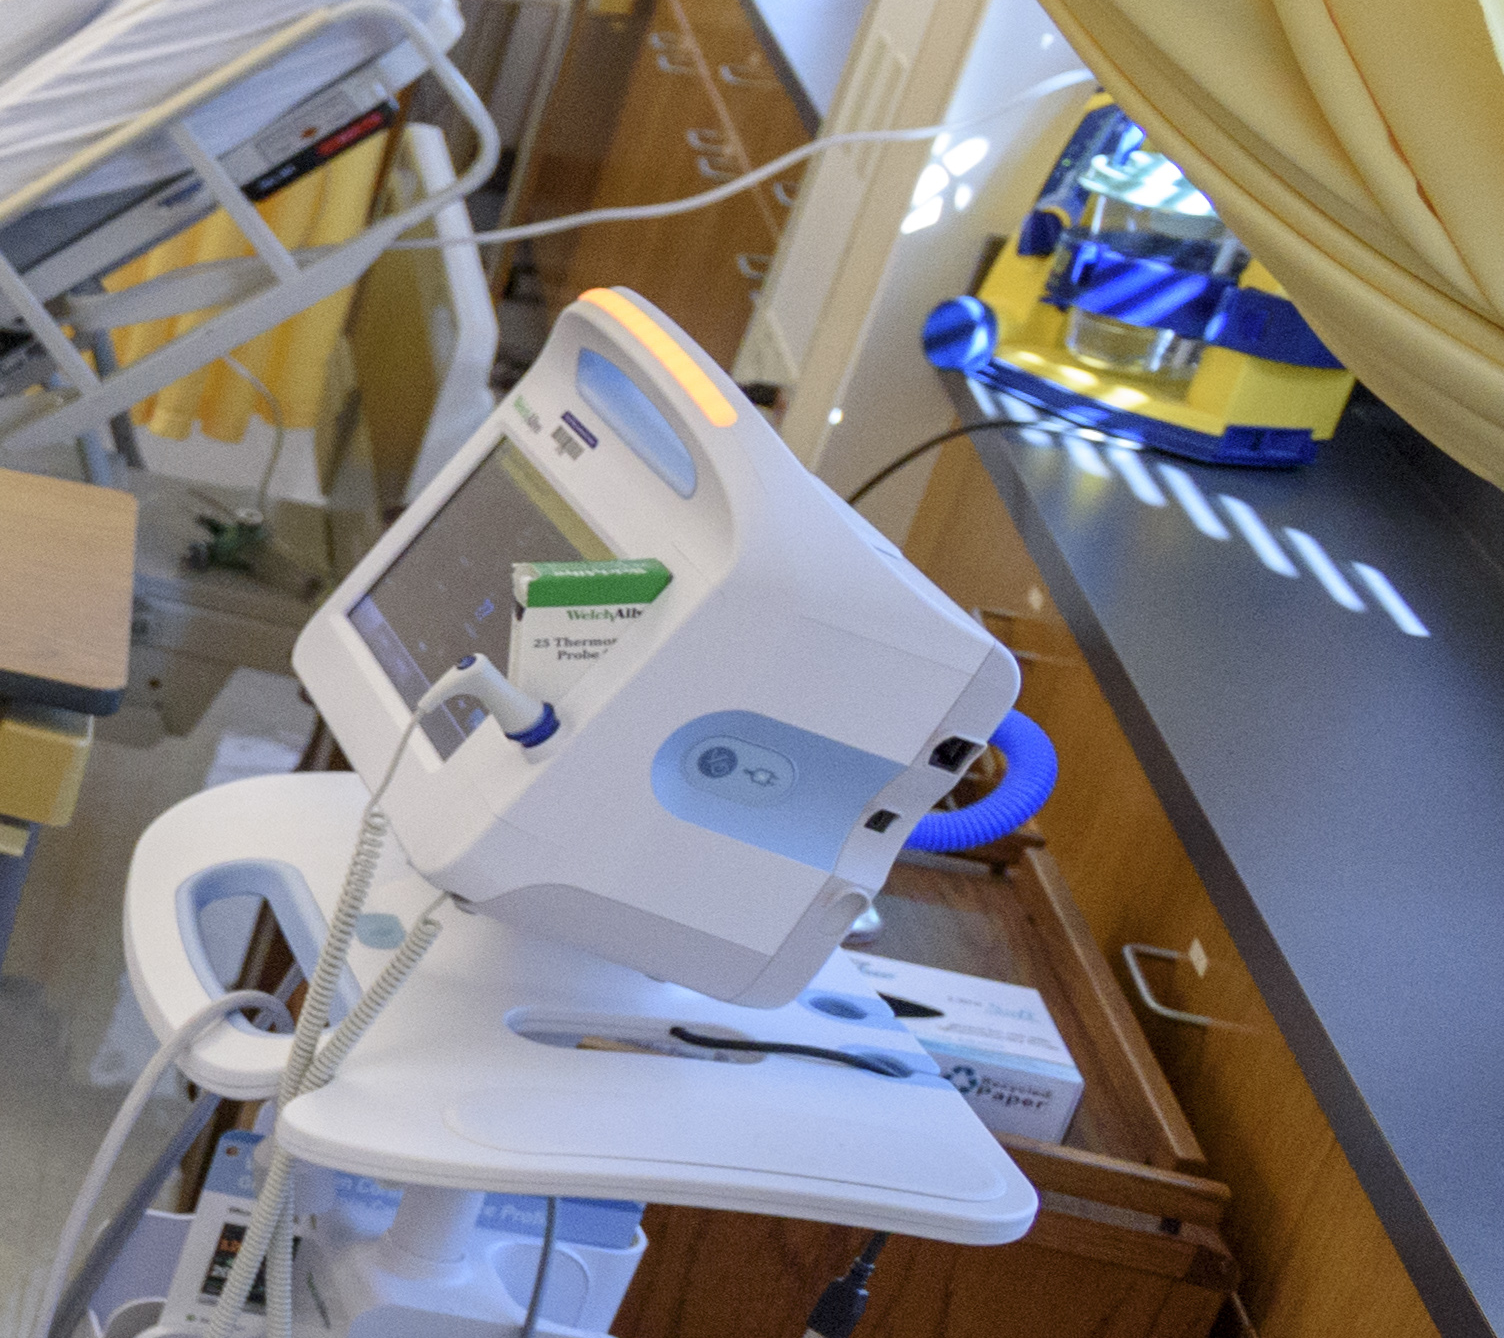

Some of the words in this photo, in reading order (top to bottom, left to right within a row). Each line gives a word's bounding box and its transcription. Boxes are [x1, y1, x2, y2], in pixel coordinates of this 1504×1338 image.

[534, 638, 551, 648] 25
[557, 649, 600, 660] Probe
[976, 1082, 1046, 1109] Paper
